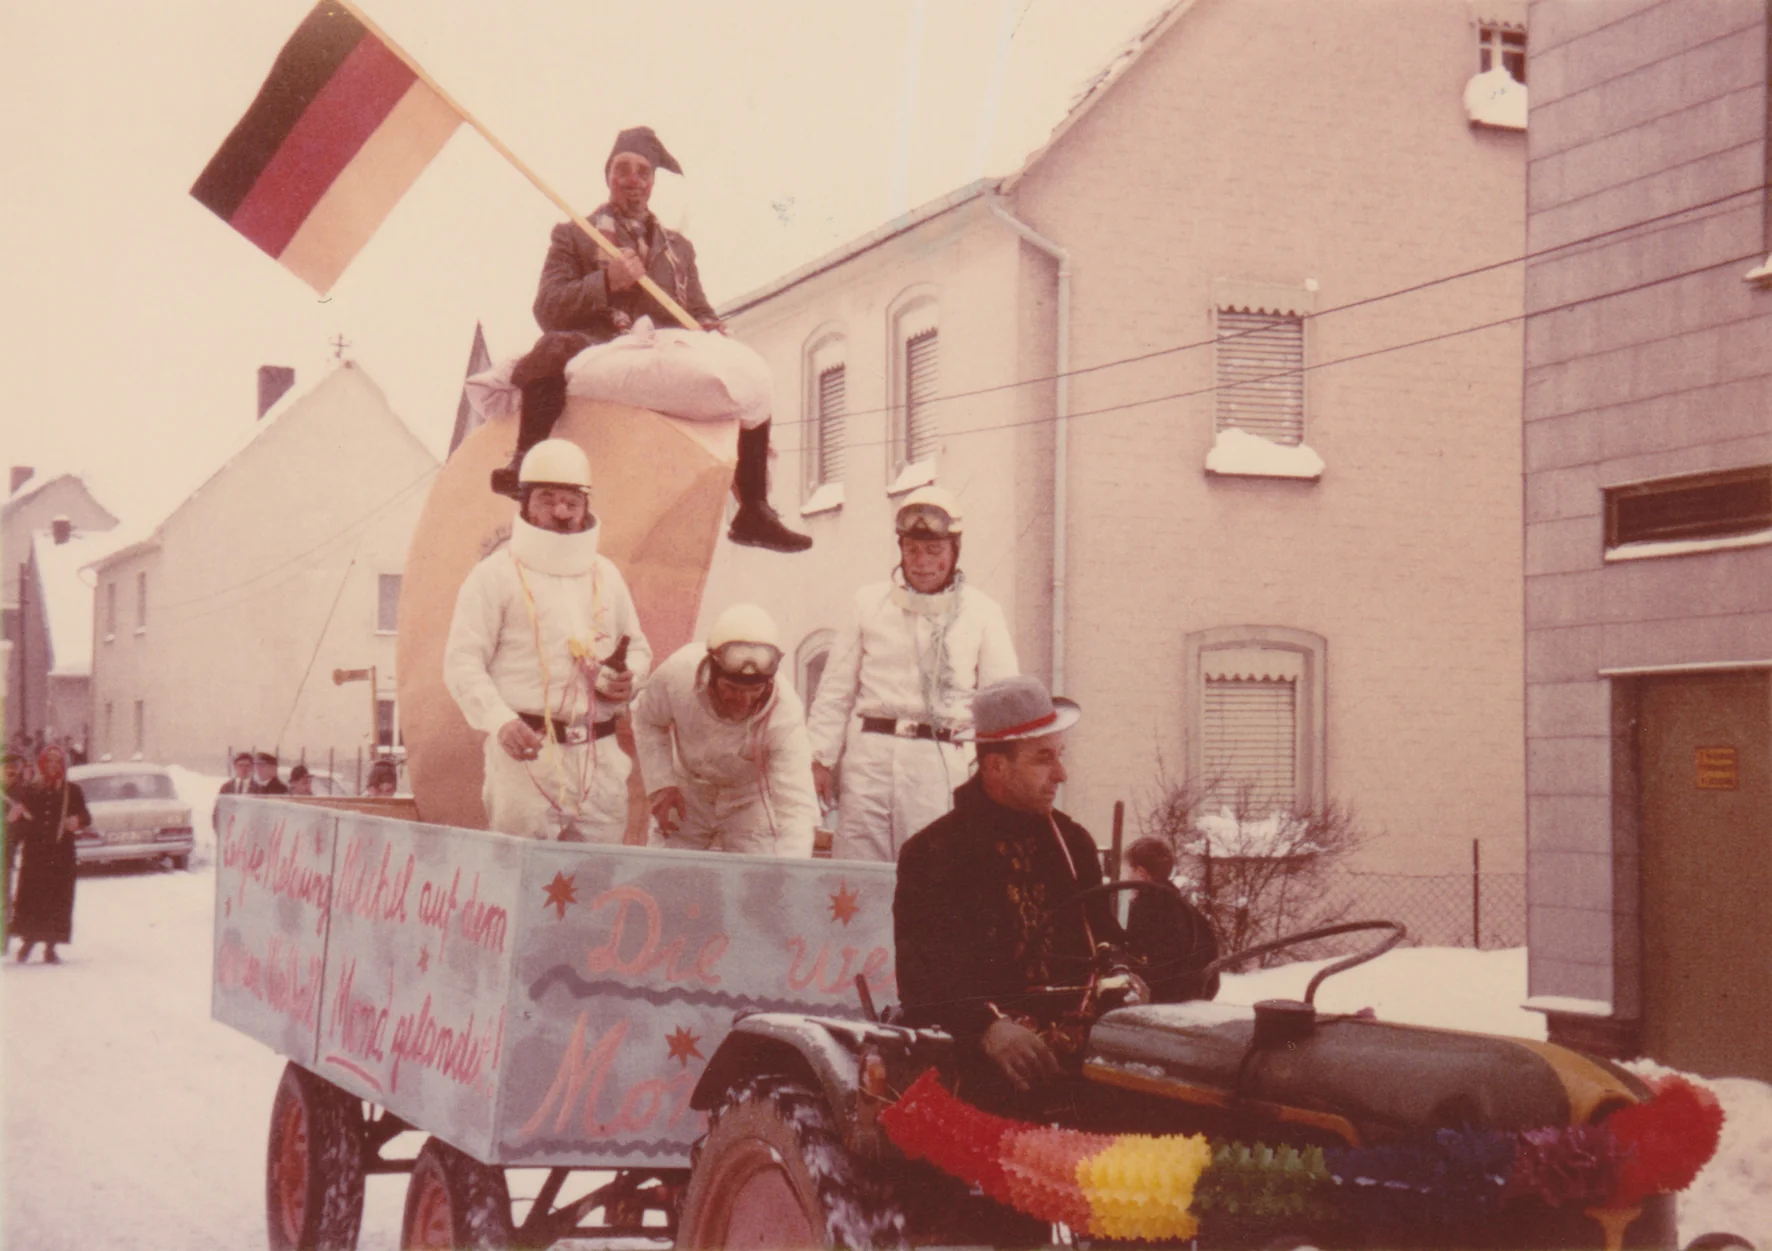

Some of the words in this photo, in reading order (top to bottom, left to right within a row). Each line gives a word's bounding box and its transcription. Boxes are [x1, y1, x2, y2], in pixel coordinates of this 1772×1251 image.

[335, 838, 414, 923] Michel
[419, 867, 460, 963] auf
[462, 873, 508, 953] dem
[588, 886, 729, 986] Die
[329, 955, 395, 1062] Mond
